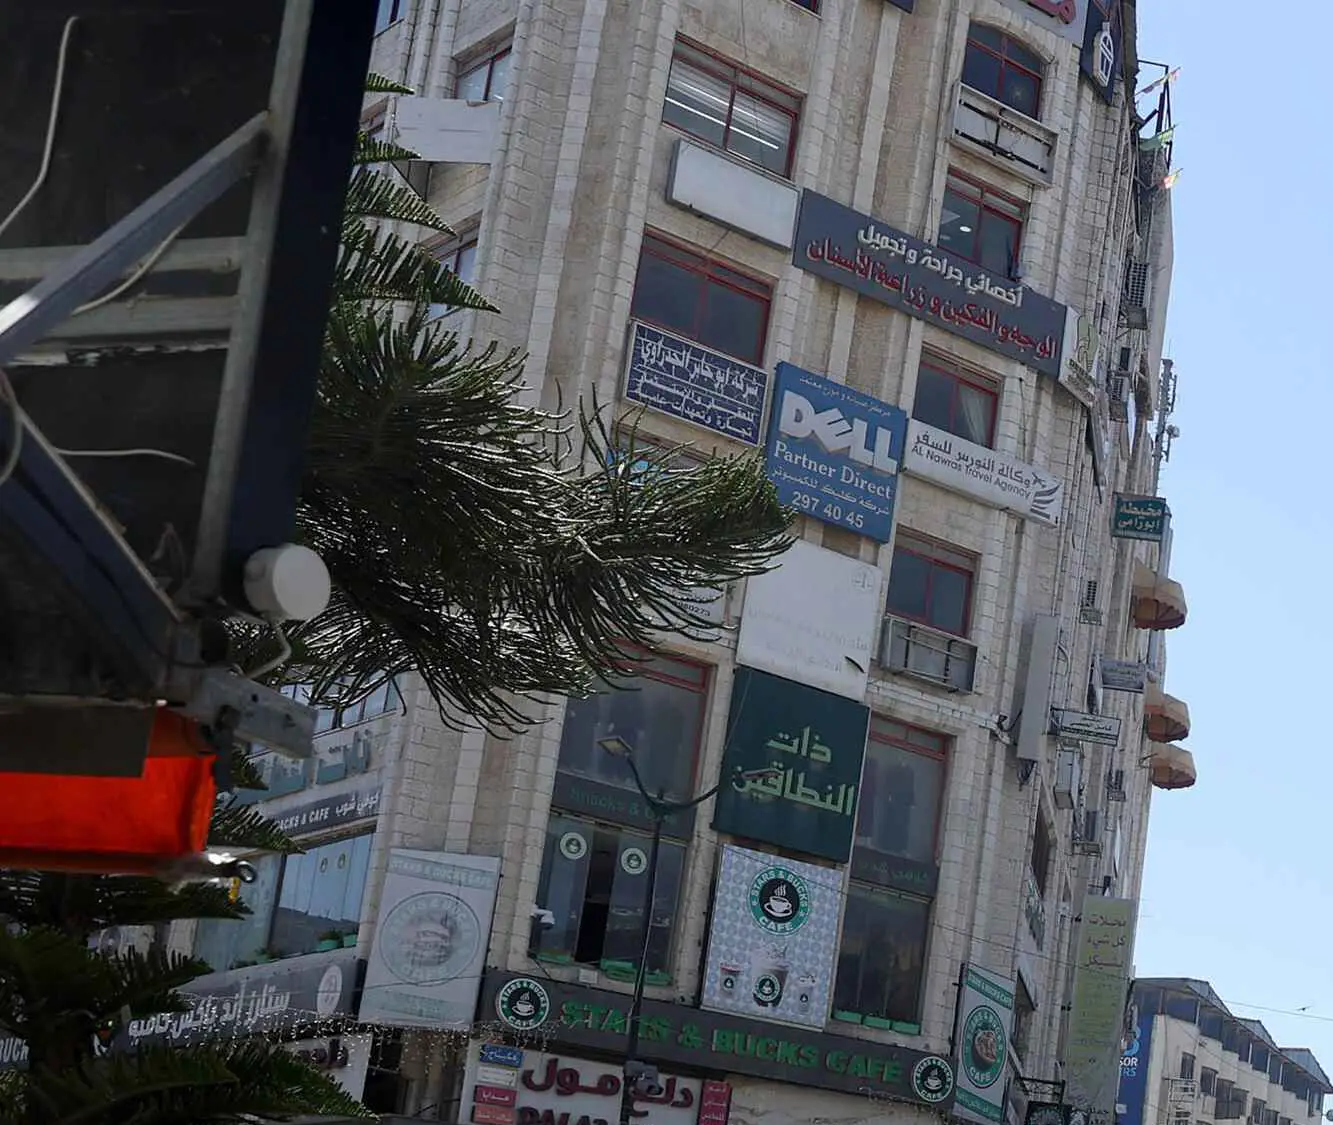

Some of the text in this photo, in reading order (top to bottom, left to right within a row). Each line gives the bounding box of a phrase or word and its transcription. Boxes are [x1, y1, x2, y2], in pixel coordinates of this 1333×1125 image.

[919, 248, 965, 285] جراحة
[965, 272, 1023, 308] أخصائي
[779, 390, 898, 476] DELL
[914, 430, 953, 455] للسفر
[775, 440, 893, 500] Partner Direct
[911, 444, 1033, 500] AL Nawras Travel Agency
[998, 461, 1033, 488] وكالة
[791, 490, 864, 530] 297 40 45
[766, 726, 832, 764] ذات
[731, 760, 856, 816] النطاقين
[751, 867, 777, 897] STARS
[759, 915, 794, 932] CAFE
[507, 1016, 535, 1027] CAFE
[677, 1024, 703, 1049] &
[711, 1029, 820, 1069] BUCKS
[521, 1056, 622, 1098] مول
[969, 1066, 992, 1083] CAFE
